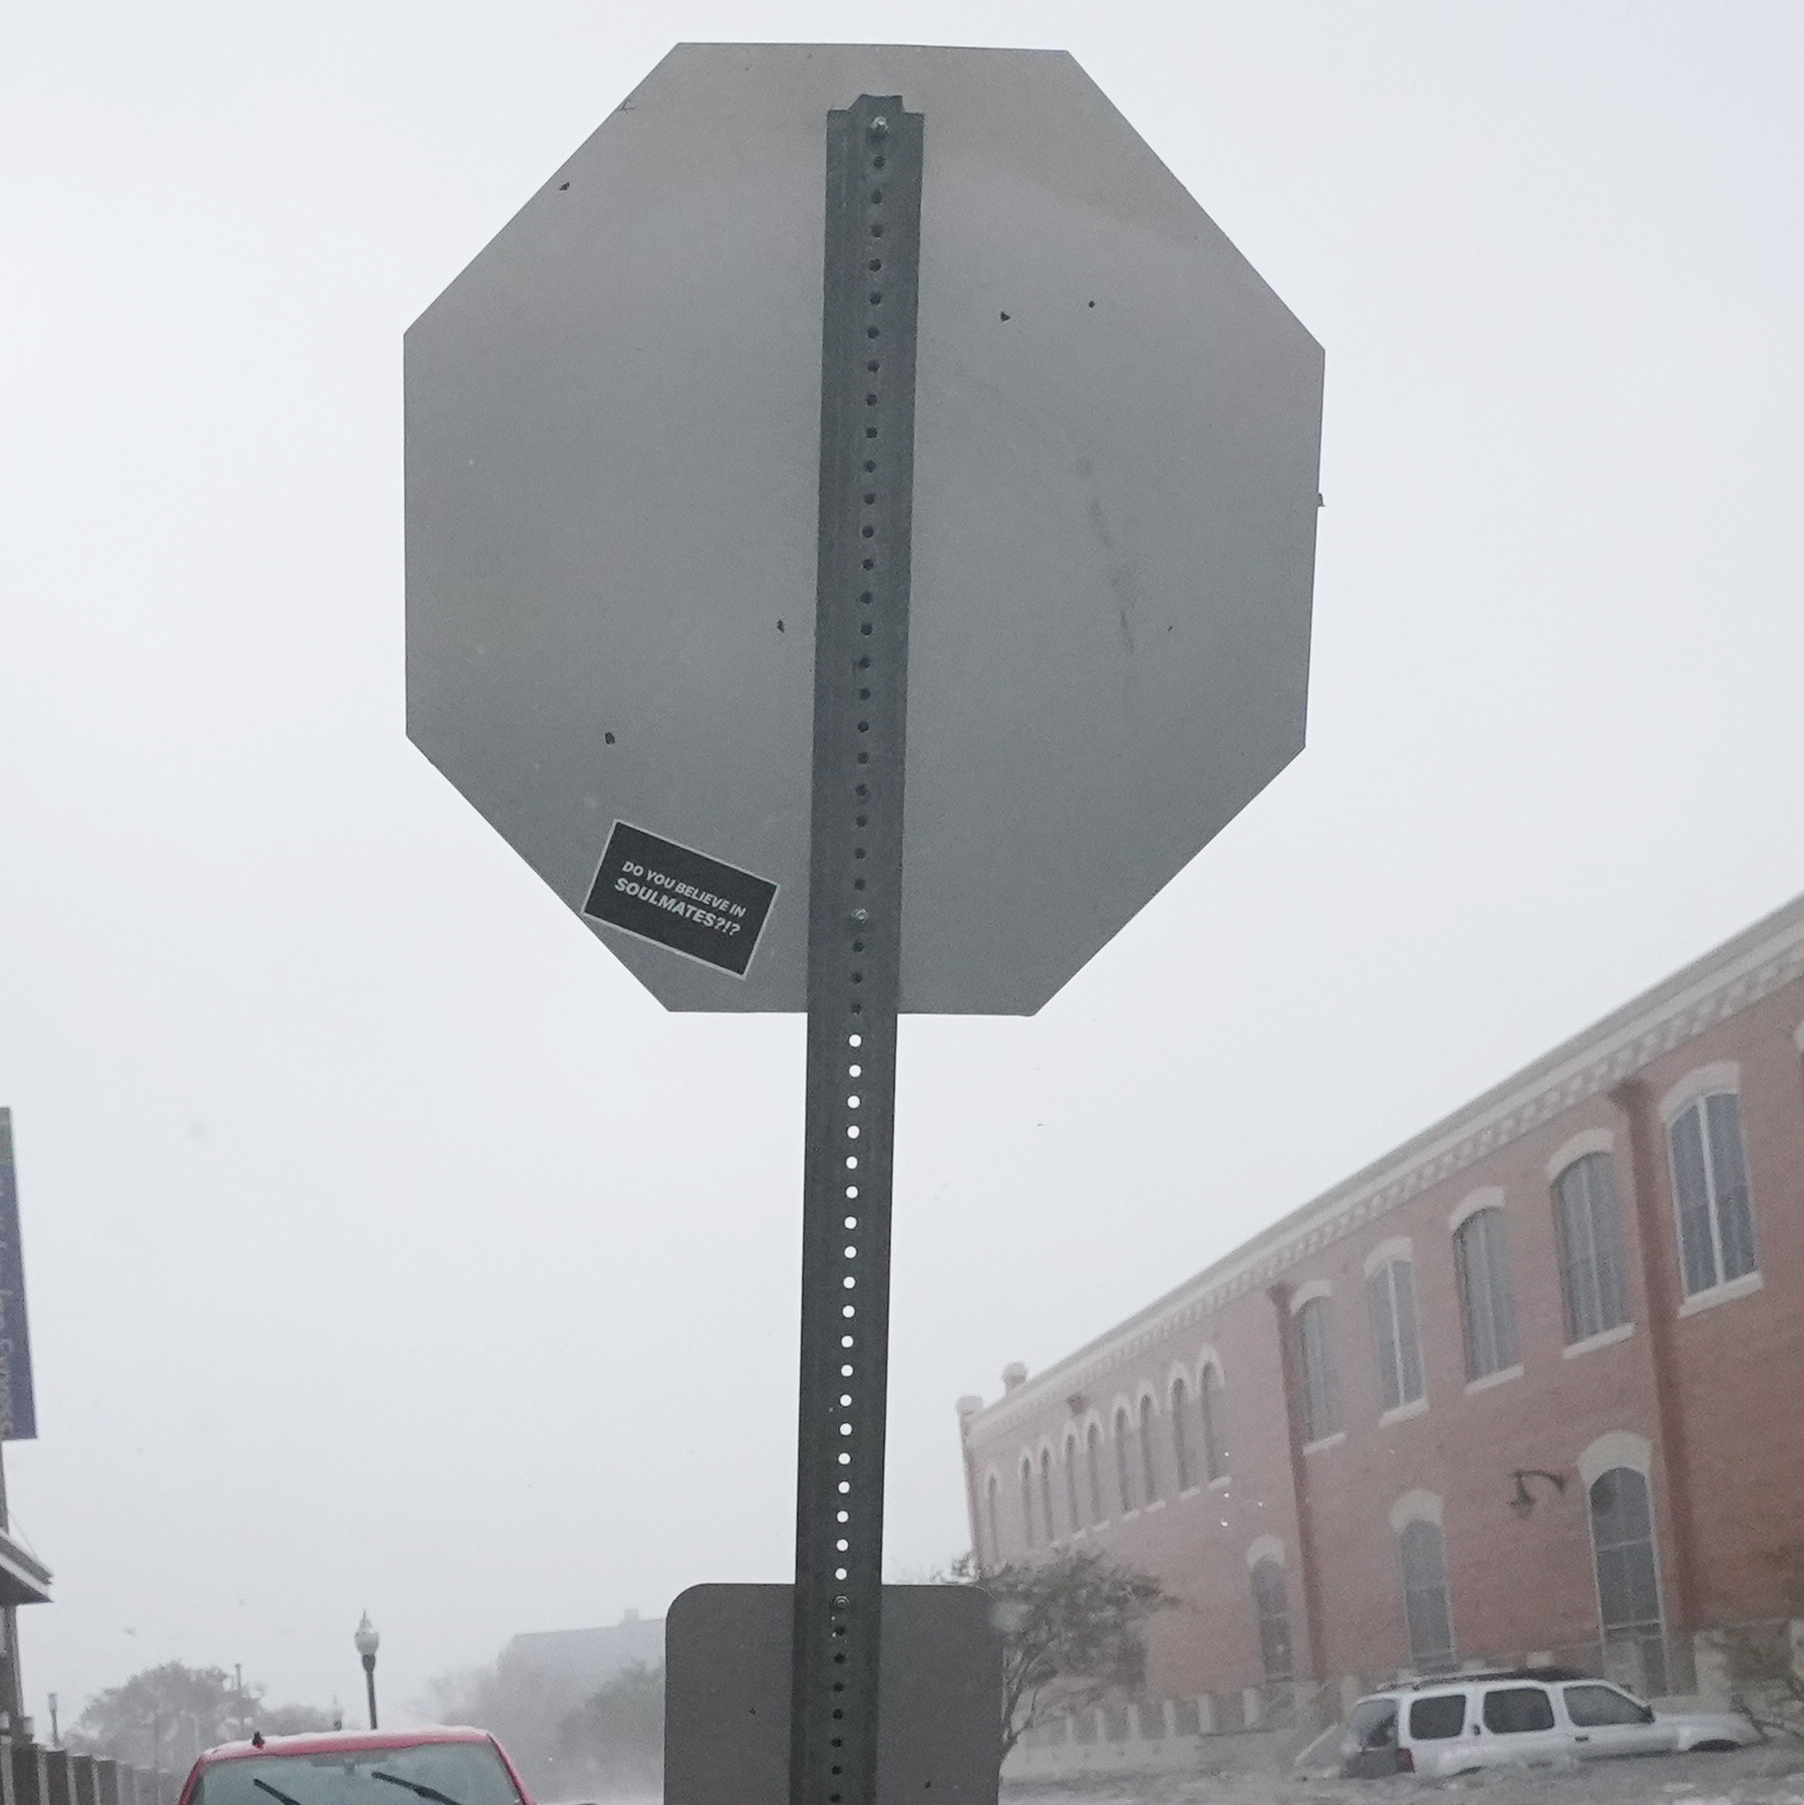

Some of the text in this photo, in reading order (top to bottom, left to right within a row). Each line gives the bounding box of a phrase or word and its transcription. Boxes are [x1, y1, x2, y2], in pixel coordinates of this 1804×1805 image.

[614, 877, 741, 936] SOULMATES?!?
[622, 861, 747, 918] DO YOU BELIEVE IN
